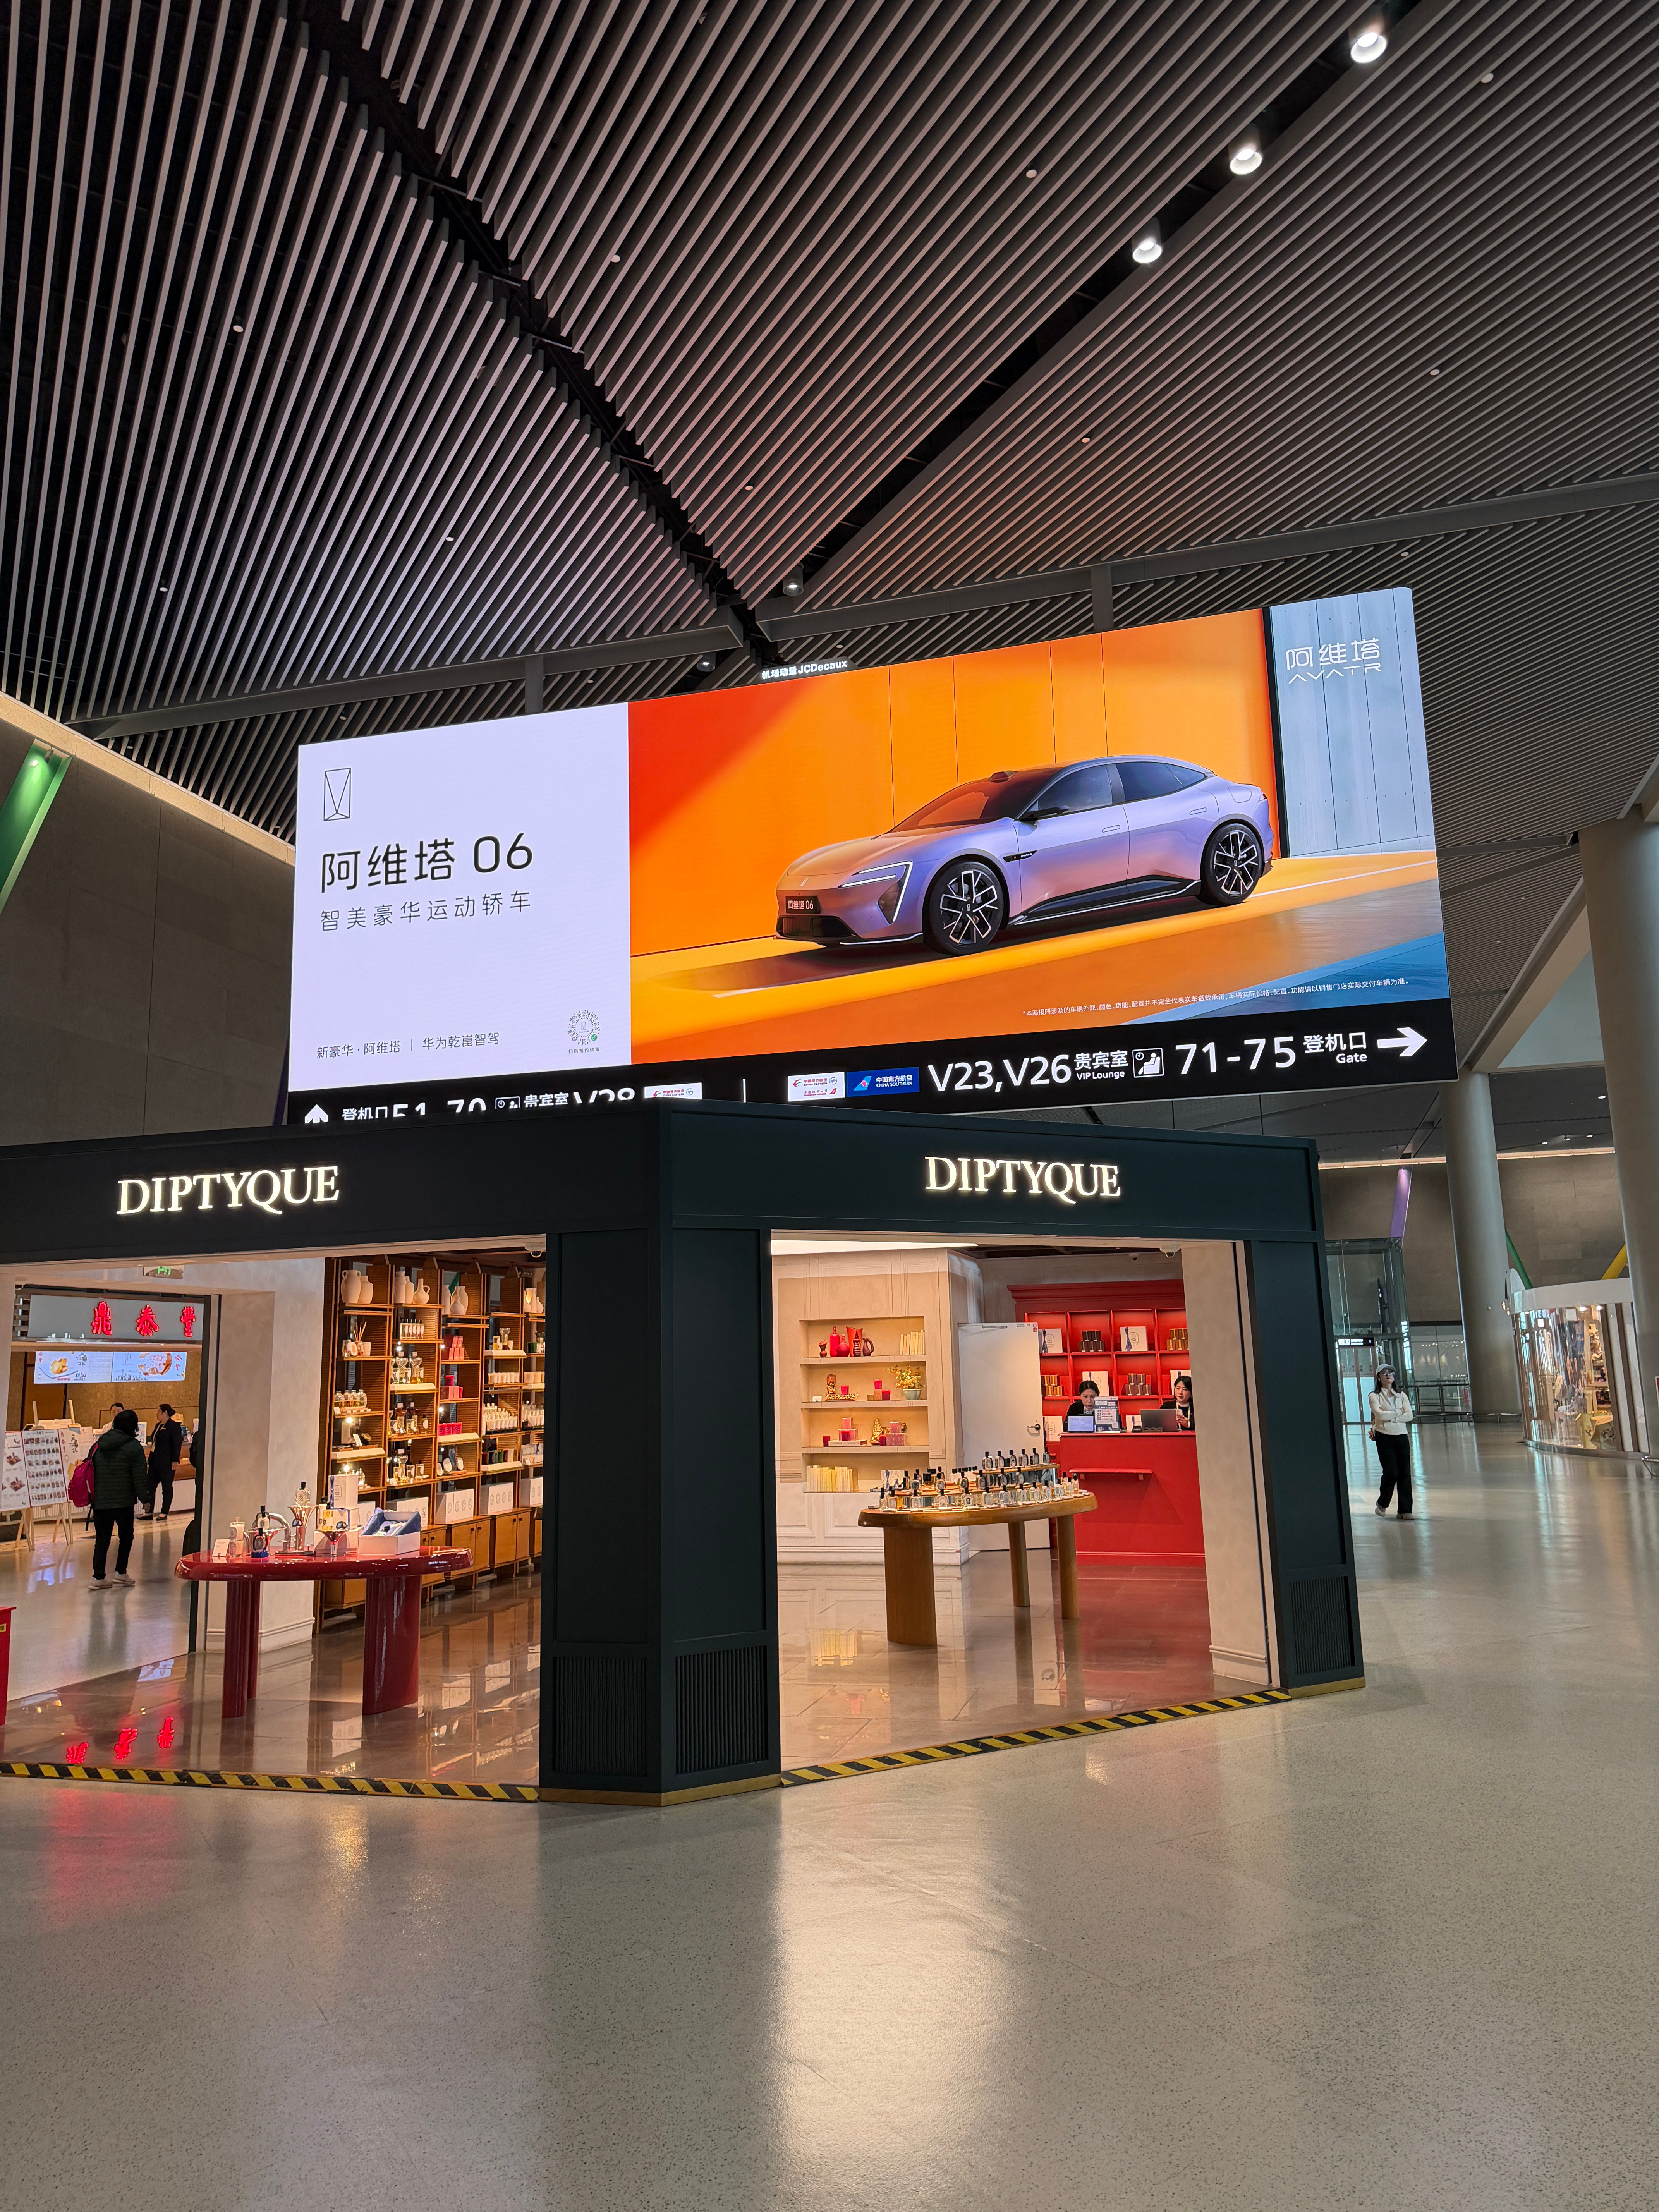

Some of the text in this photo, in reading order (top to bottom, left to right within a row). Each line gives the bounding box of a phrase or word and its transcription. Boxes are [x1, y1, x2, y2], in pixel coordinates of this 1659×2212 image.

[798, 660, 847, 674] JCDecaux
[1286, 637, 1380, 671] 阿维塔
[321, 832, 533, 893] 阿维塔 06
[320, 890, 531, 931] 智美豪华运动轿车
[805, 900, 814, 910] 06
[1175, 1036, 1296, 1075] 71-75
[1303, 1031, 1367, 1054] 登机口
[1074, 1050, 1129, 1071] 贵宾室
[1336, 1053, 1367, 1064] Gate
[1076, 1070, 1125, 1081] VIP Lounge
[116, 1165, 339, 1214] DIPTYQUE
[924, 1156, 1121, 1204] DIPTYQUE
